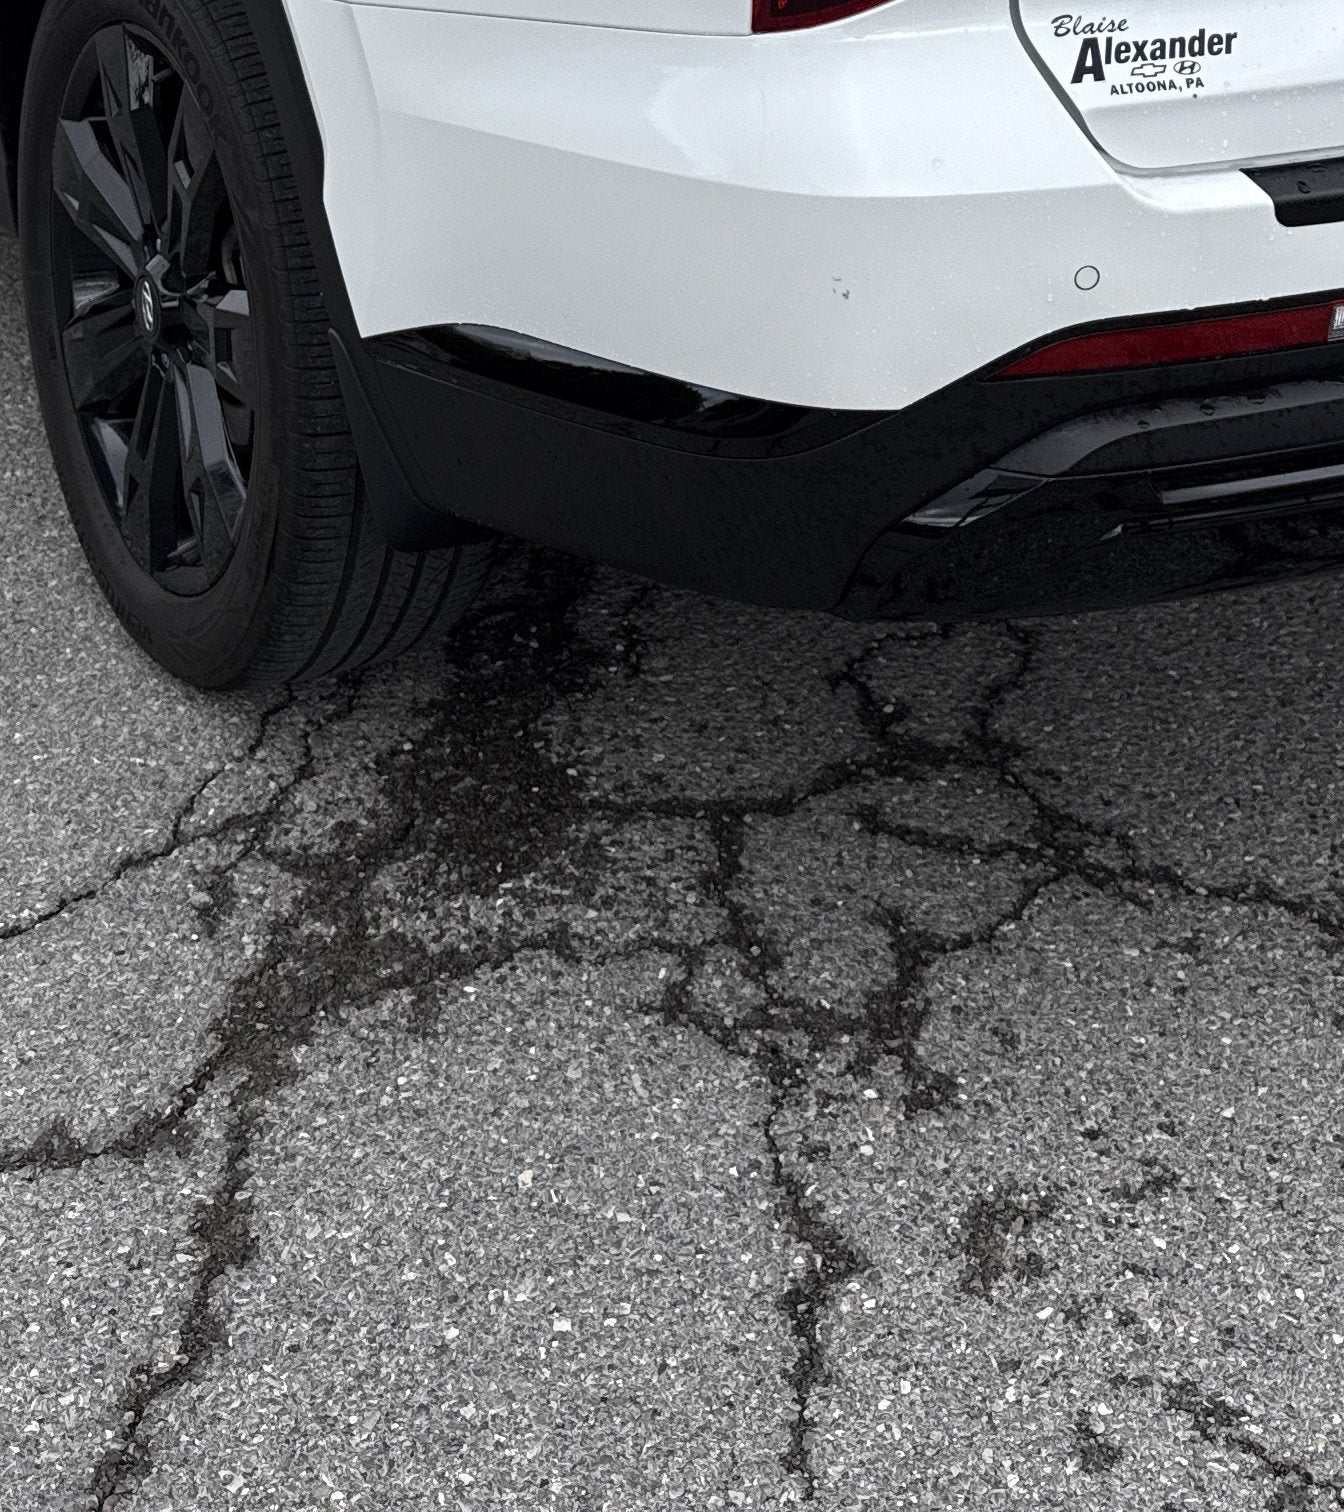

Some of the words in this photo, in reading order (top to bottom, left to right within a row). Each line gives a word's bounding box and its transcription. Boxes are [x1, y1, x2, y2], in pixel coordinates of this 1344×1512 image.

[1051, 14, 1129, 37] Blaise
[1070, 28, 1238, 84] Alexander
[1110, 79, 1183, 96] ALTOONA,
[1185, 77, 1205, 89] PA
